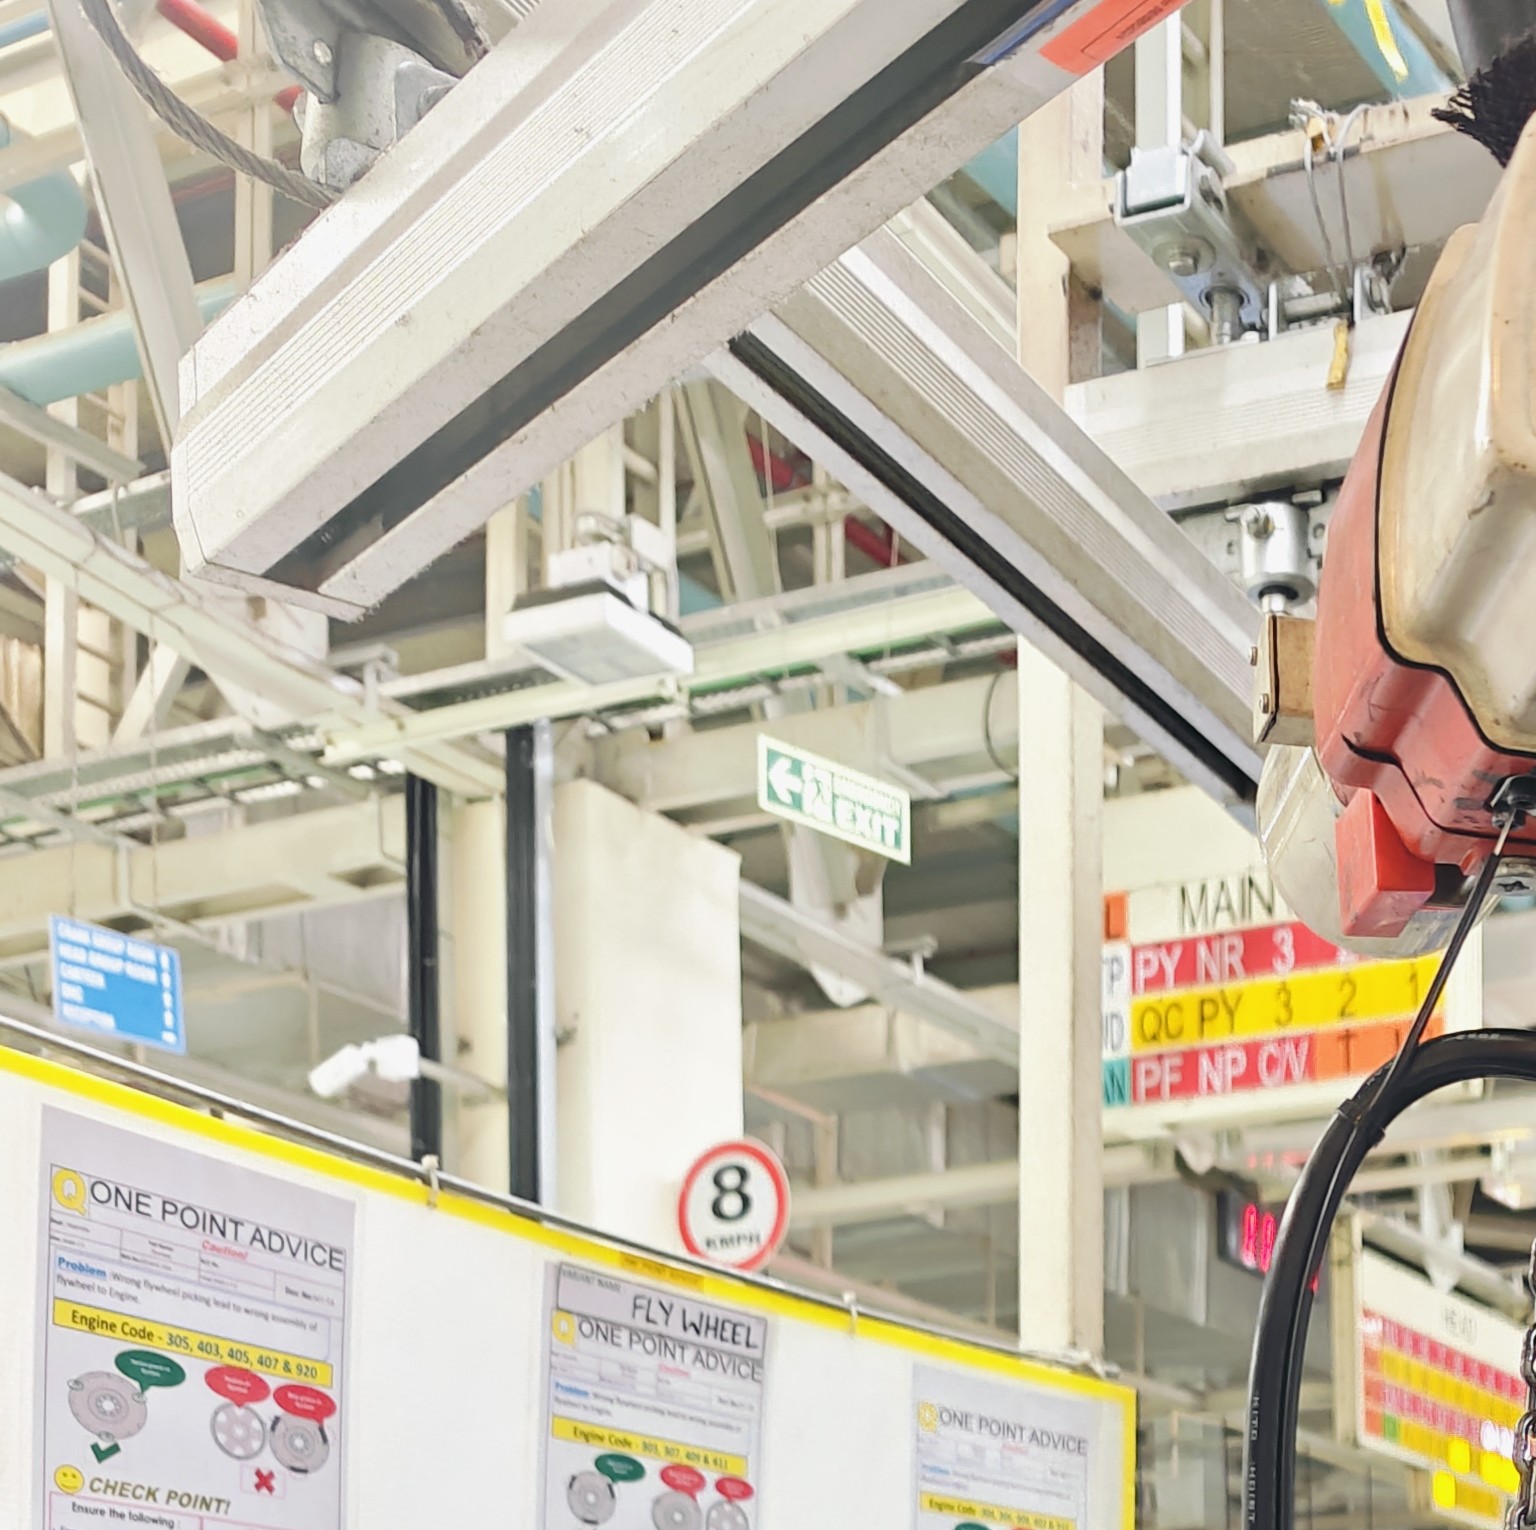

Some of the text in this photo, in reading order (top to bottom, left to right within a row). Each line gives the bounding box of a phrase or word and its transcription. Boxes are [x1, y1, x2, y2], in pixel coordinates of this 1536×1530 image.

[835, 798, 900, 850] EXIT
[1179, 875, 1276, 933] MAIN
[1135, 944, 1183, 994] PY
[1196, 934, 1246, 982] NR
[1271, 927, 1295, 975] 3
[1139, 1002, 1184, 1043] QC
[1200, 990, 1244, 1039] PY
[1273, 981, 1294, 1027] 3
[1338, 972, 1358, 1020] 2
[1136, 1053, 1183, 1104] PF
[1200, 1045, 1247, 1095] NP
[712, 1165, 752, 1220] 8
[90, 1181, 152, 1217] ONE
[161, 1199, 245, 1242] POINT
[250, 1226, 344, 1272] ADVICE
[71, 1310, 117, 1335] Engine
[121, 1321, 155, 1341] Code
[632, 1294, 759, 1349] FLY WHEEL
[578, 1318, 623, 1348] ONE
[628, 1326, 688, 1363] POINT
[692, 1349, 763, 1383] ADVICE
[939, 1406, 975, 1432] ONE
[978, 1416, 1025, 1443] POINT
[1028, 1429, 1088, 1456] ADVICE
[71, 1501, 175, 1530] Ensure the following
[89, 1477, 232, 1515] CHECK POINT!
